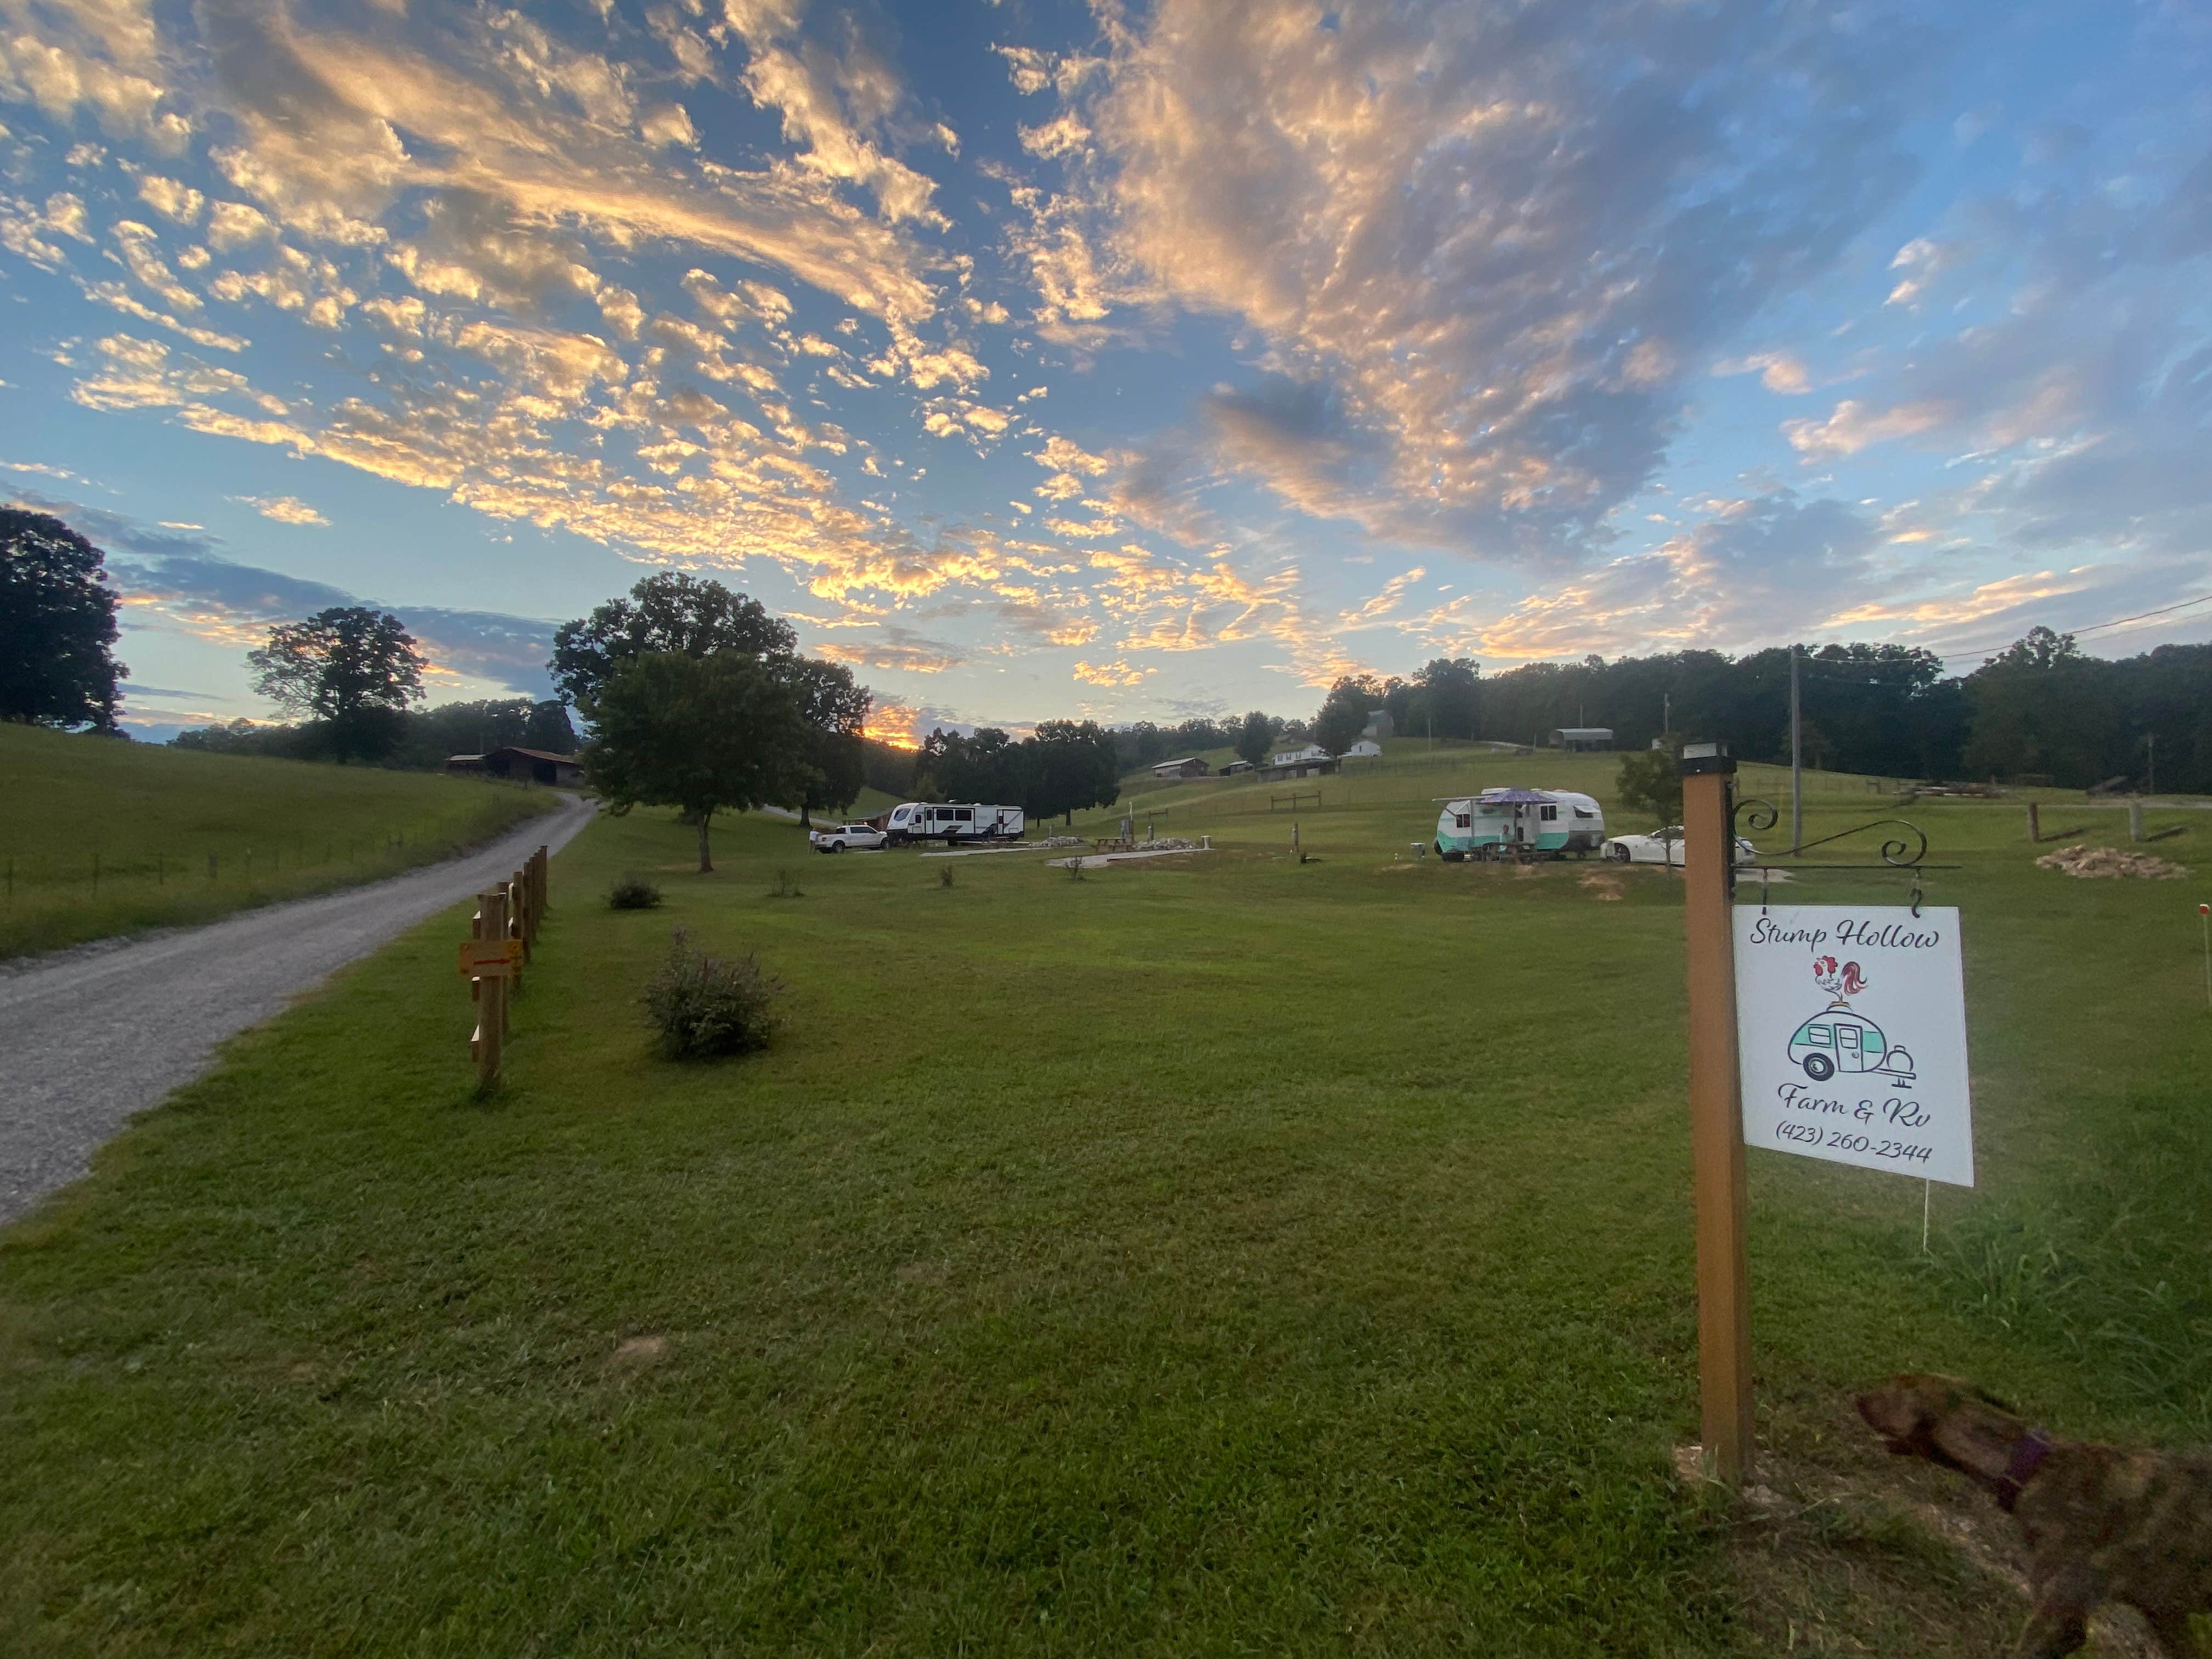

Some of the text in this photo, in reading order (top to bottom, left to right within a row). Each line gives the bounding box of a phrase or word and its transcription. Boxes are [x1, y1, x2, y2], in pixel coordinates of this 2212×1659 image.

[1750, 918, 1939, 952] Stump Hollow
[1778, 1083, 1931, 1127] Farm & Rv
[1776, 1121, 1933, 1164] (423) 260-2344
